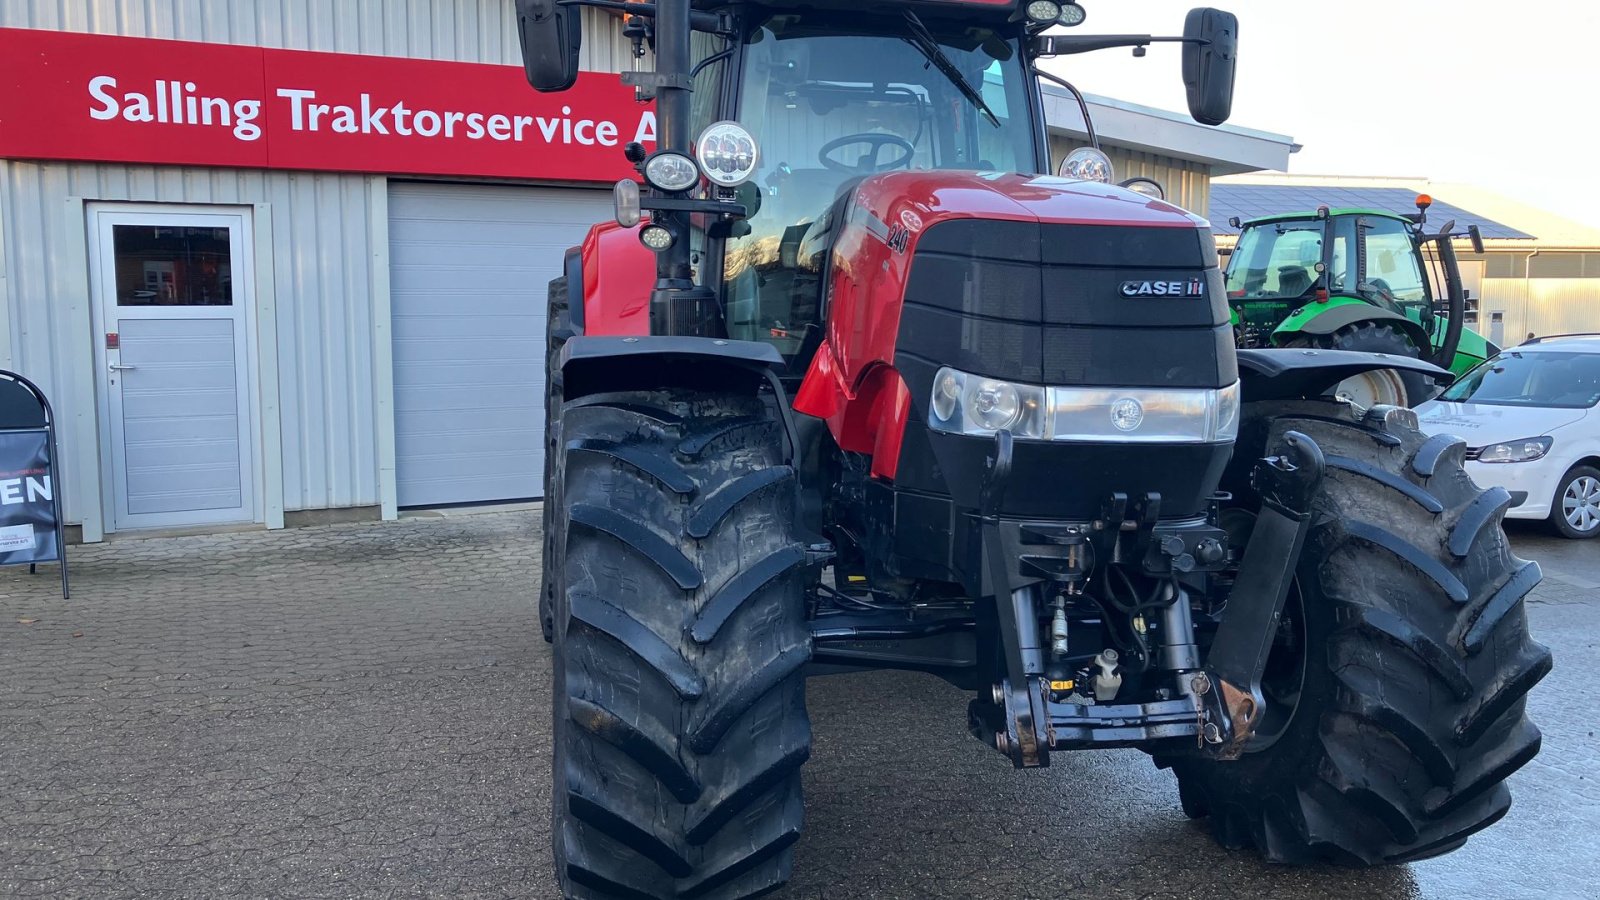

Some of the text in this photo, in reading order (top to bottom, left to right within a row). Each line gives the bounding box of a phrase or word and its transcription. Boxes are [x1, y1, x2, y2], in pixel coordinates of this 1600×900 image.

[88, 75, 262, 141] Salling
[276, 88, 619, 147] Traktorservice
[887, 222, 909, 255] 240
[1122, 280, 1182, 296] CASE
[0, 475, 53, 505] EN
